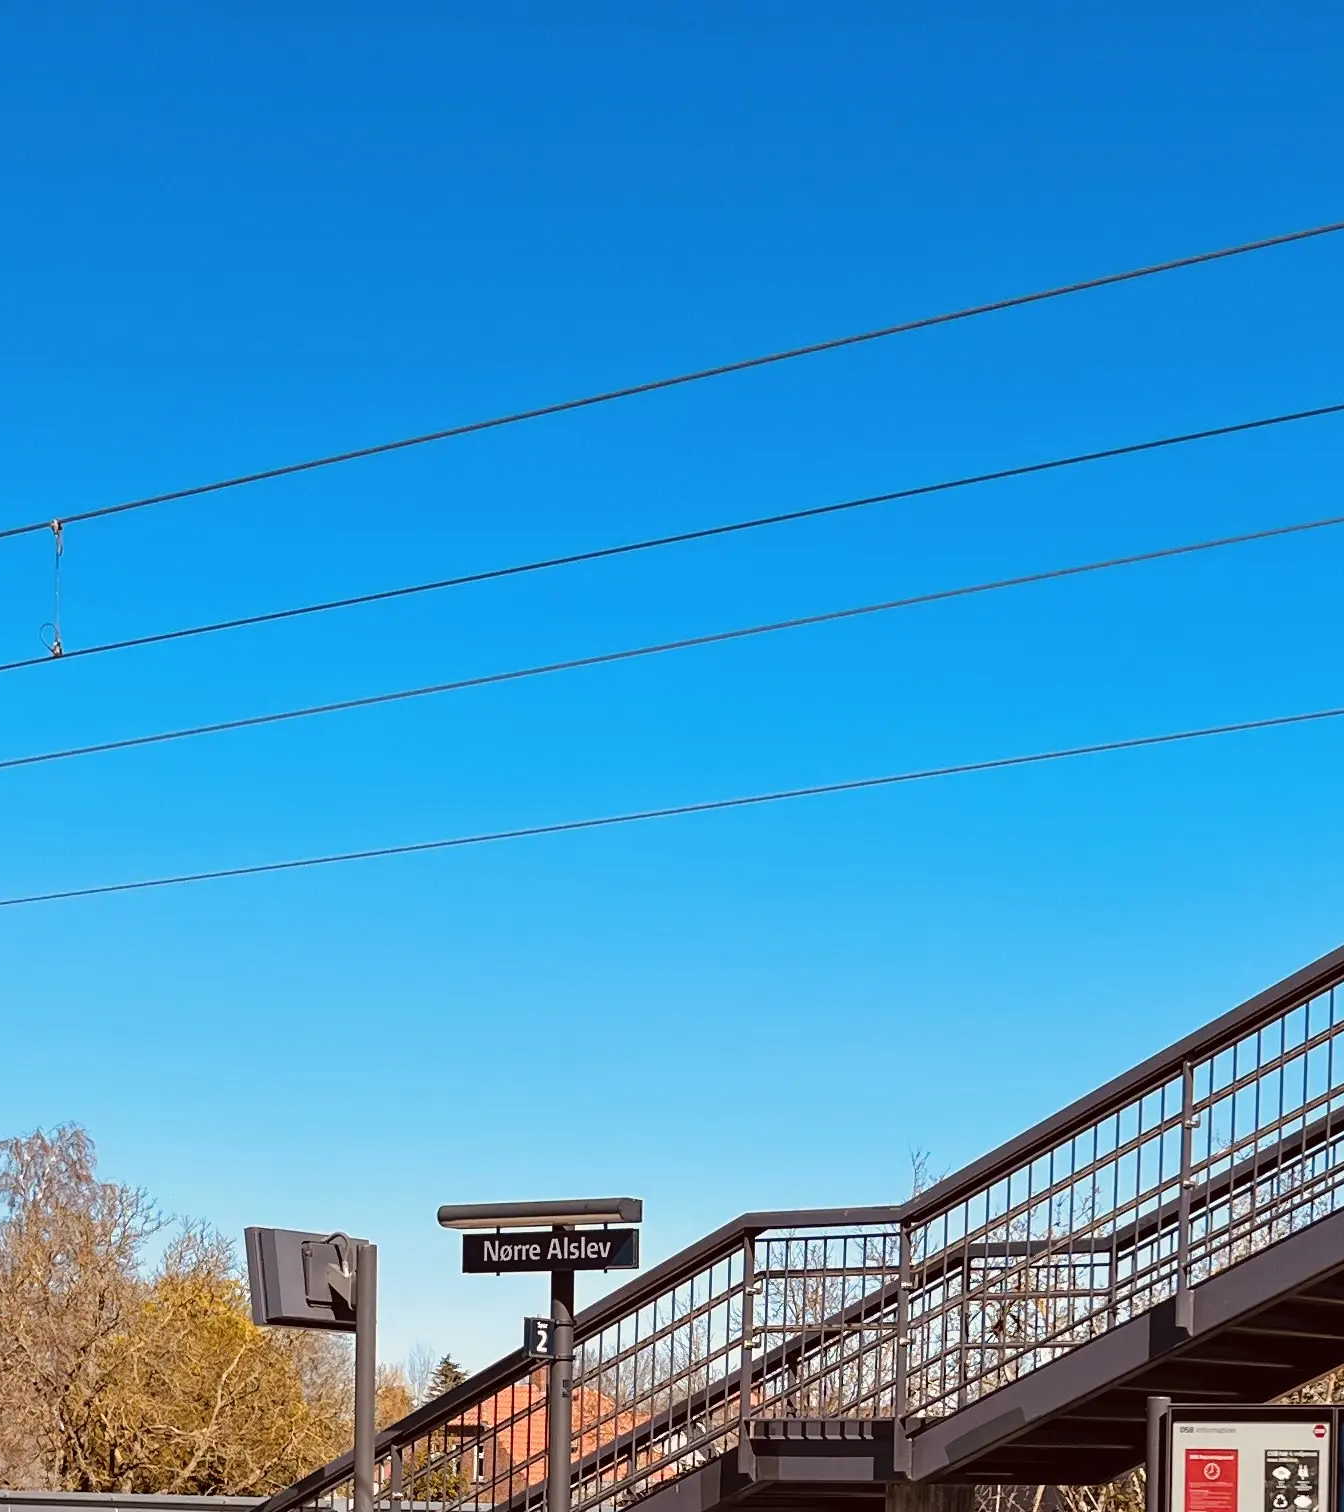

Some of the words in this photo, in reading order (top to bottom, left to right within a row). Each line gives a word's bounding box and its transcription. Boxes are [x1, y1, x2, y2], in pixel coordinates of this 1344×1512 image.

[483, 1239, 542, 1262] Nørre
[546, 1236, 612, 1261] Alslev
[536, 1330, 548, 1352] 2
